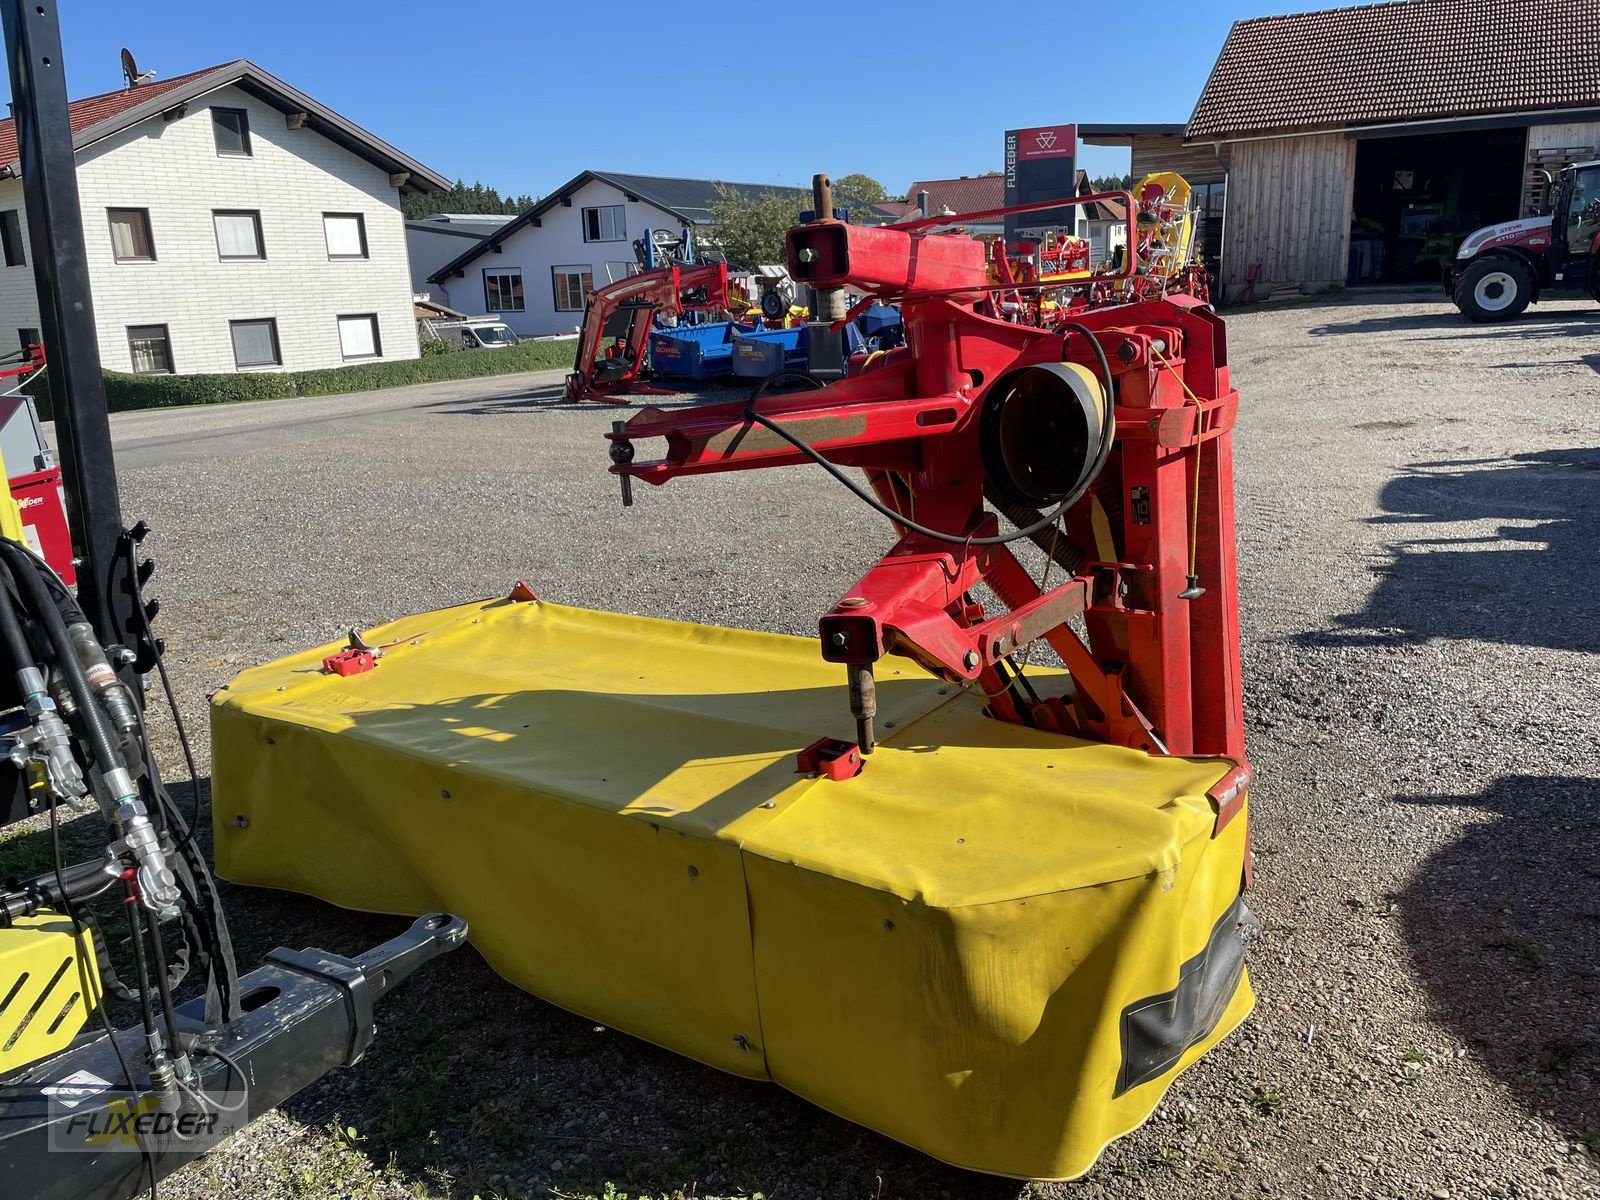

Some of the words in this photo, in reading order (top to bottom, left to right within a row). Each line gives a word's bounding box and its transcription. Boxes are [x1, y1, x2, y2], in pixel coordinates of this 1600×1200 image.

[1007, 135, 1016, 188] FLIXEDER
[1499, 224, 1522, 234] STEYR
[1496, 234, 1515, 242] 4110
